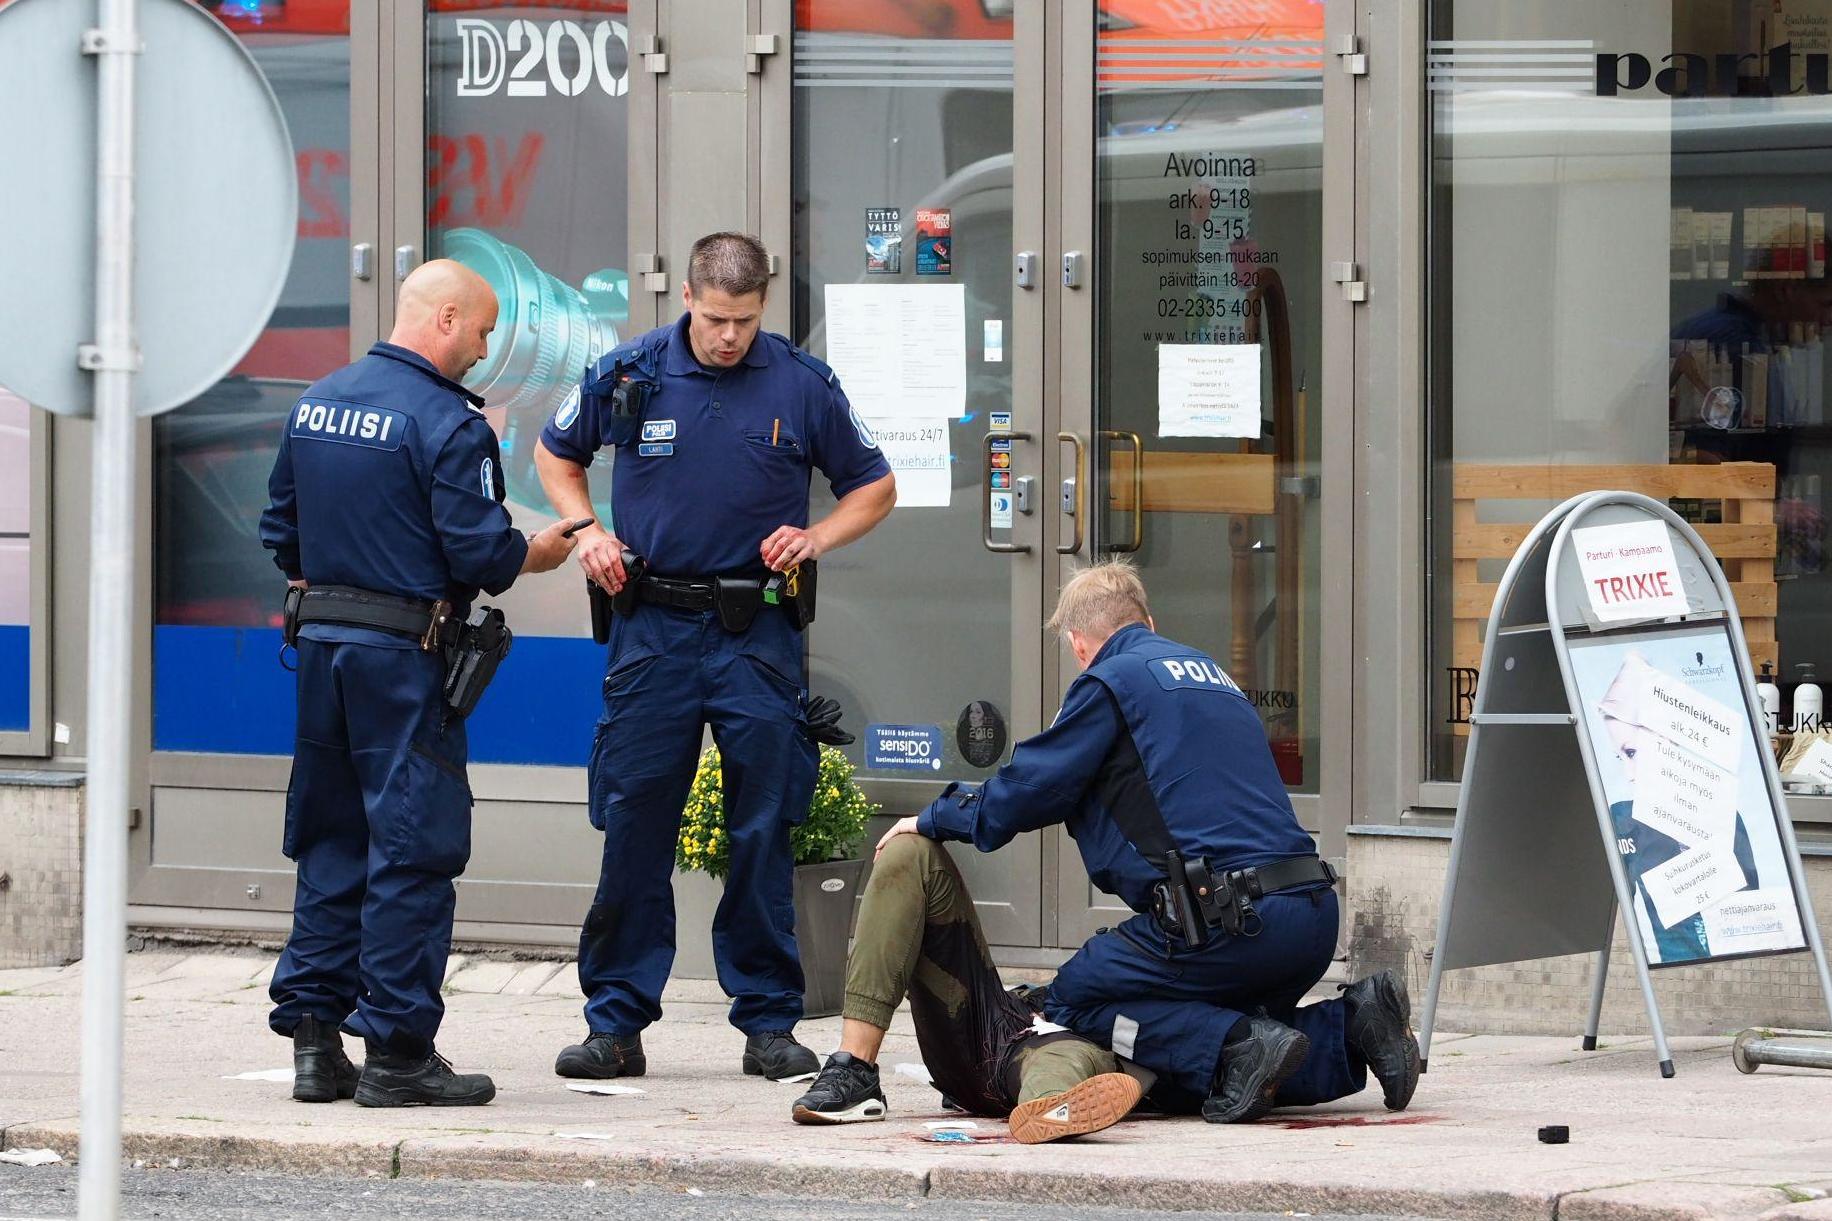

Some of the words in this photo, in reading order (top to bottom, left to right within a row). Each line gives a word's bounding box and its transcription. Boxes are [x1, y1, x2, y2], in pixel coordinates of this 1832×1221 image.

[456, 19, 629, 97] D200
[1163, 152, 1256, 177] Avoinna
[1169, 188, 1203, 209] ark.
[1209, 188, 1250, 209] 9-18
[867, 223, 899, 232] VARIS
[1175, 219, 1196, 240] la.
[1202, 219, 1244, 240] 9-15
[1142, 249, 1221, 266] sopimuksen
[1225, 249, 1279, 264] mukaan
[1159, 272, 1218, 290] päivittäin
[1223, 272, 1260, 287] 18-20
[1158, 298, 1226, 318] 02-2335
[1230, 298, 1262, 318] 400
[295, 403, 393, 441] POLIISI
[919, 428, 944, 443] 24/7
[1586, 549, 1614, 561] Parturi
[1619, 544, 1663, 559] Kampaamo
[1593, 571, 1674, 604] TRIXIE
[1653, 685, 1731, 736] Hiustenleikkaus
[969, 727, 994, 740] 2016
[1657, 741, 1676, 759] Tule
[1660, 767, 1688, 787] aikoja
[1673, 792, 1699, 814] ilman
